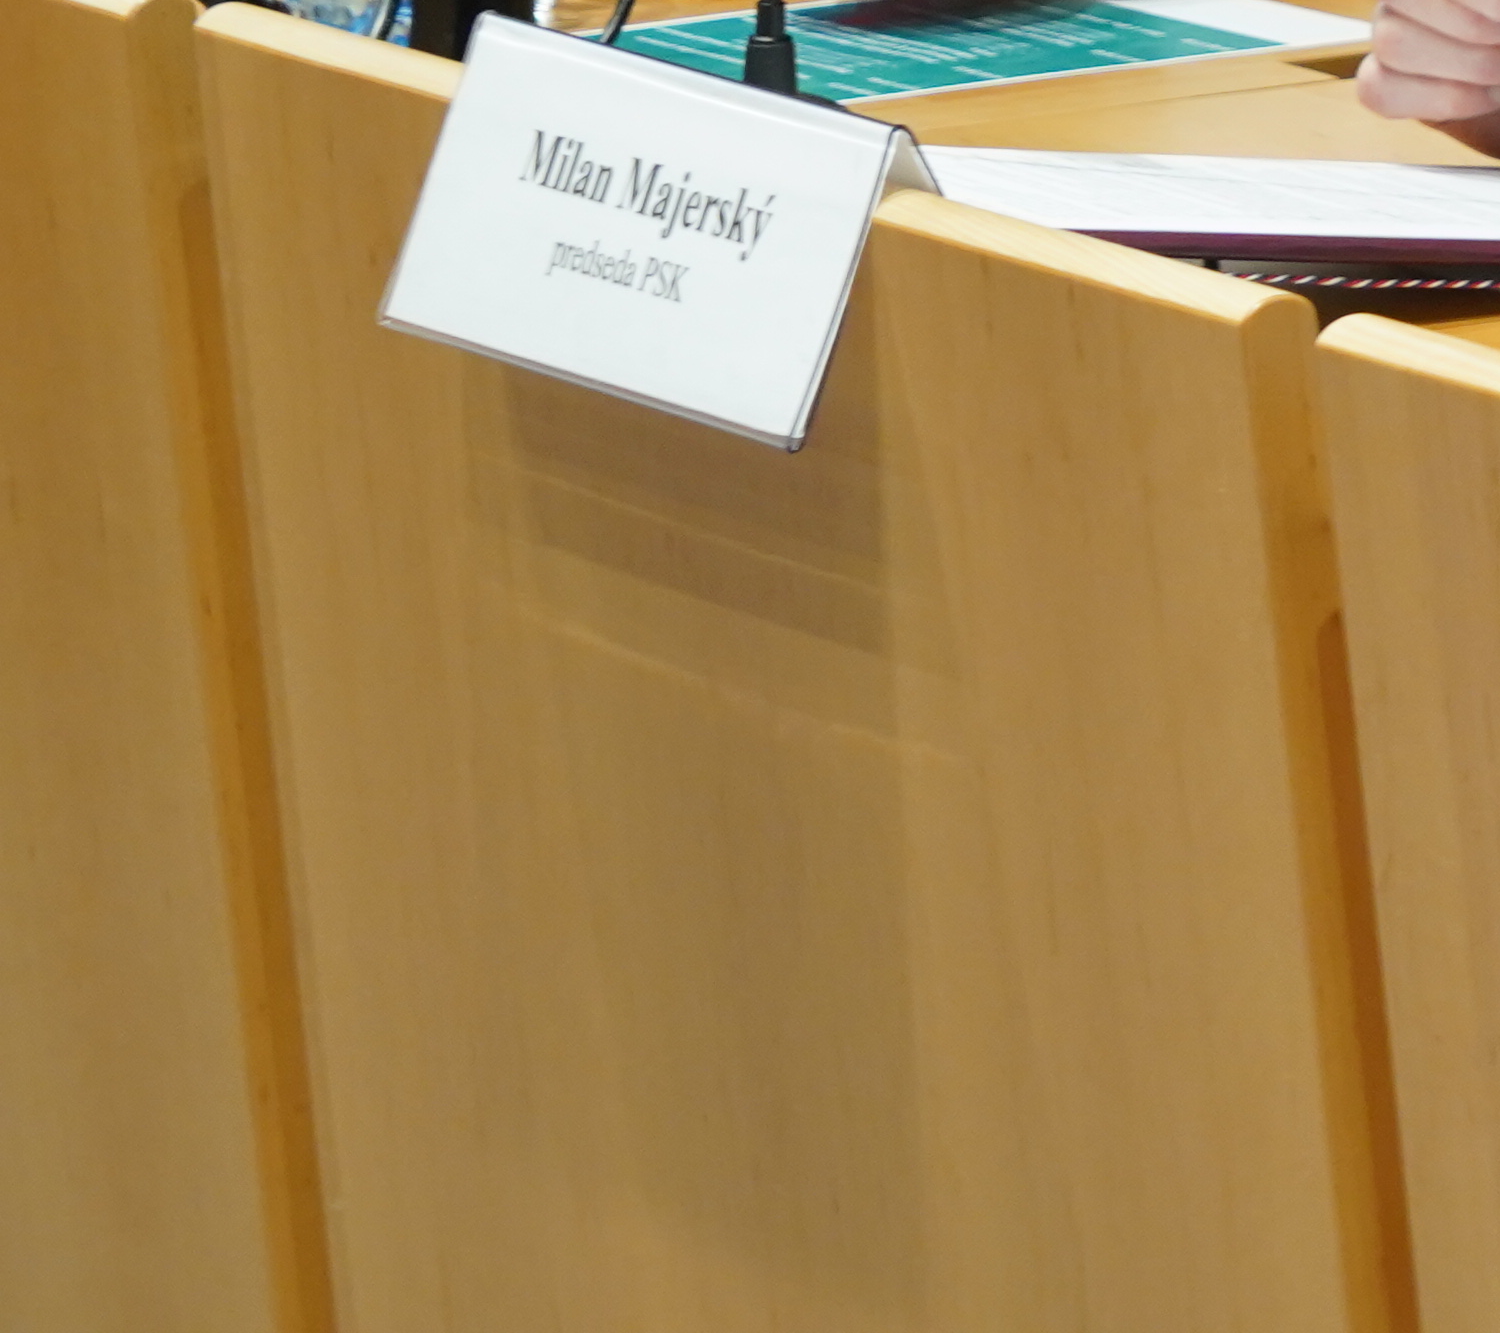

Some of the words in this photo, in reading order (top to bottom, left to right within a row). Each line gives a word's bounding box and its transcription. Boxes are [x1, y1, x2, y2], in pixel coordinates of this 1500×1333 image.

[518, 129, 614, 204] Milan
[615, 157, 777, 261] Majerský
[545, 240, 637, 287] predseda
[637, 256, 690, 303] PSK
